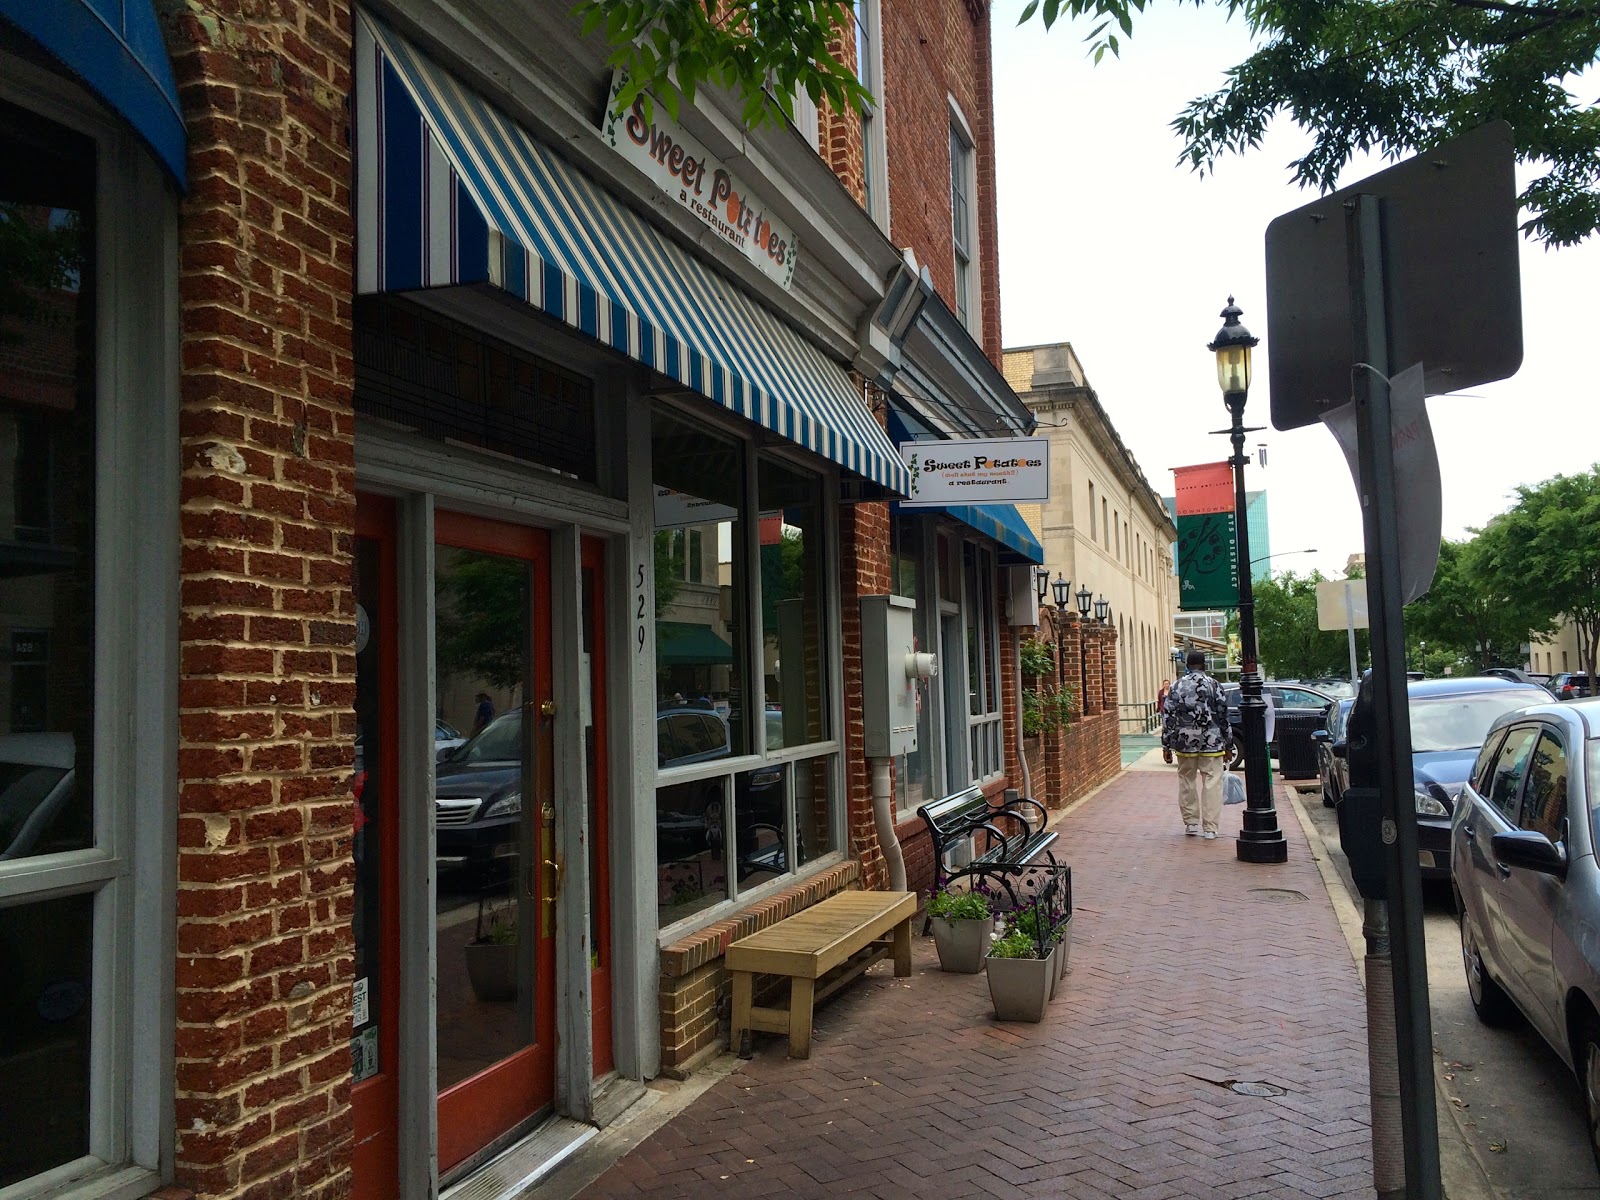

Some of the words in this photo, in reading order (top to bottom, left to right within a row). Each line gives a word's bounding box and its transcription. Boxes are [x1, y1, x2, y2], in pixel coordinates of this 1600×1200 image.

[626, 92, 706, 196] Sweet
[707, 168, 788, 268] Potatoes
[679, 187, 687, 204] a
[690, 200, 746, 249] restaurant
[923, 458, 971, 472] Sweet
[974, 456, 1042, 470] Potatoes
[1177, 506, 1225, 515] DOWNTOWN
[1229, 539, 1238, 588] DISTRICT
[636, 563, 645, 653] 529
